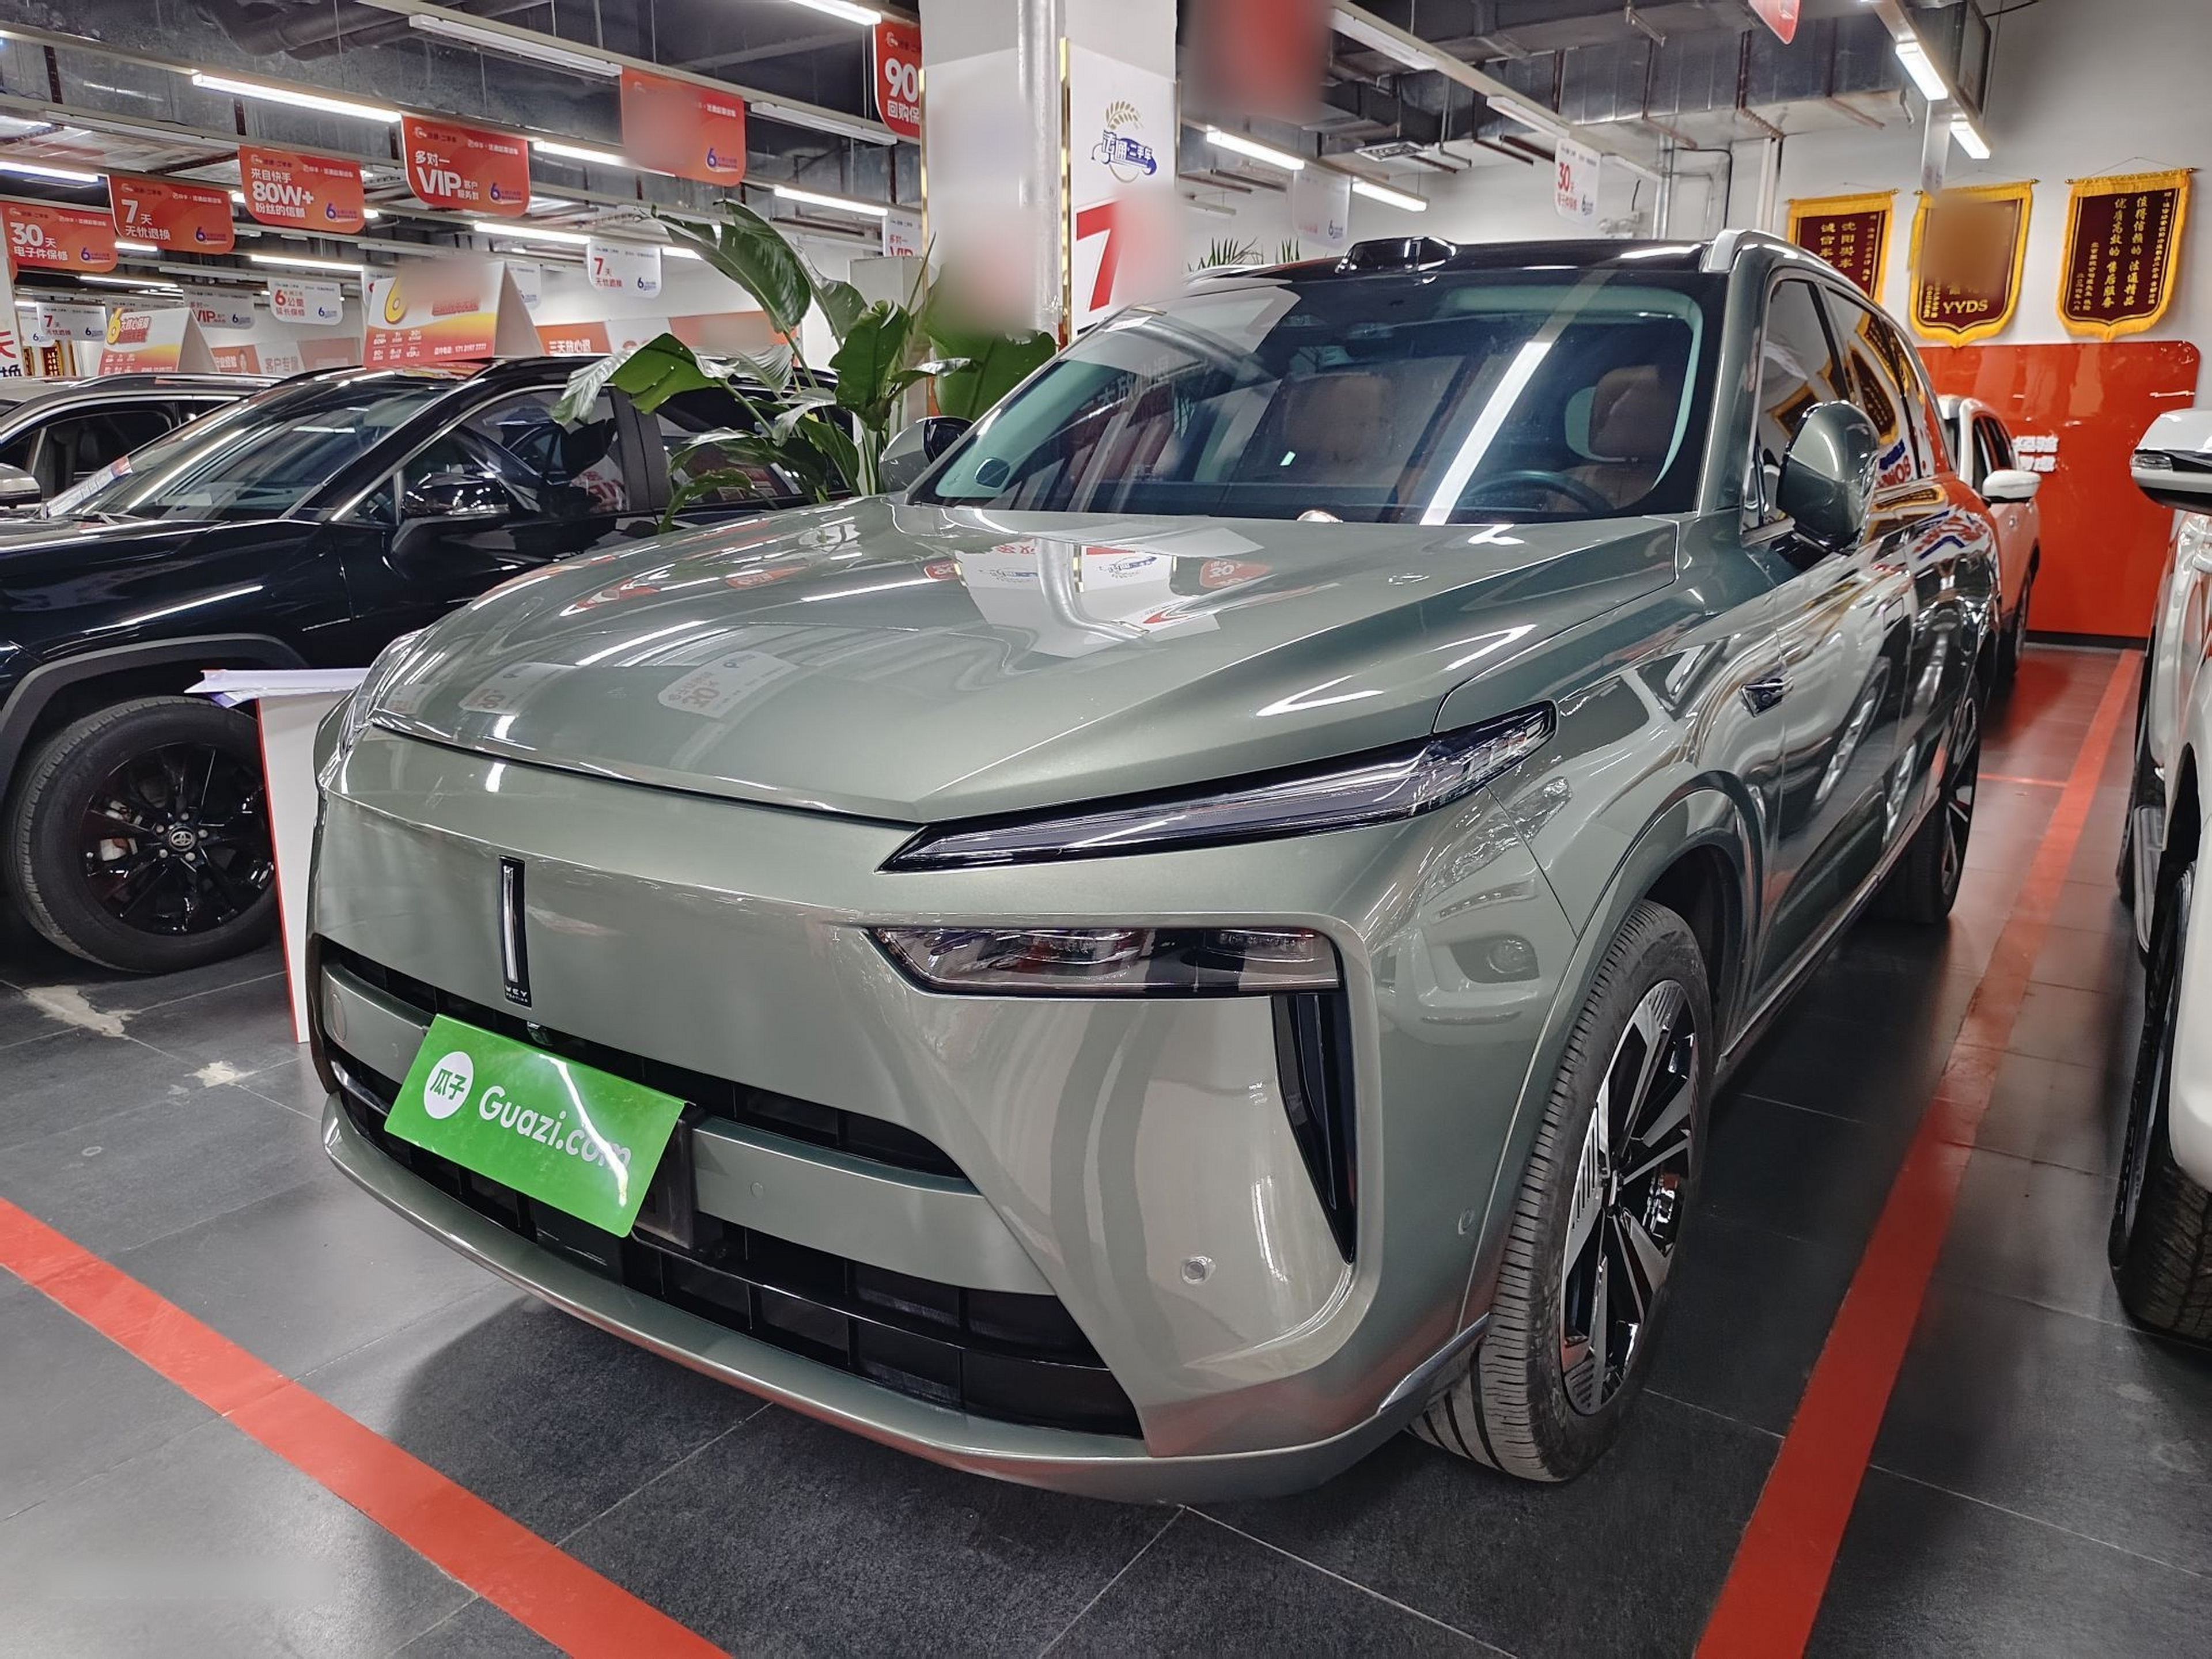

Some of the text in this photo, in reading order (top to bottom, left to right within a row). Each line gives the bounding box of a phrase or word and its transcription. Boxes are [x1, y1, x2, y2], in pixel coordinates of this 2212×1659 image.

[884, 58, 919, 103] 90
[415, 150, 450, 166] 多对一
[251, 168, 292, 183] 来自快手
[416, 166, 461, 196] VIP
[252, 181, 314, 206] 80W+
[126, 225, 171, 240] 无忧退换
[14, 245, 69, 261] 电子件保修
[1943, 299, 1988, 314] YYDS
[430, 1068, 467, 1100] 瓜子
